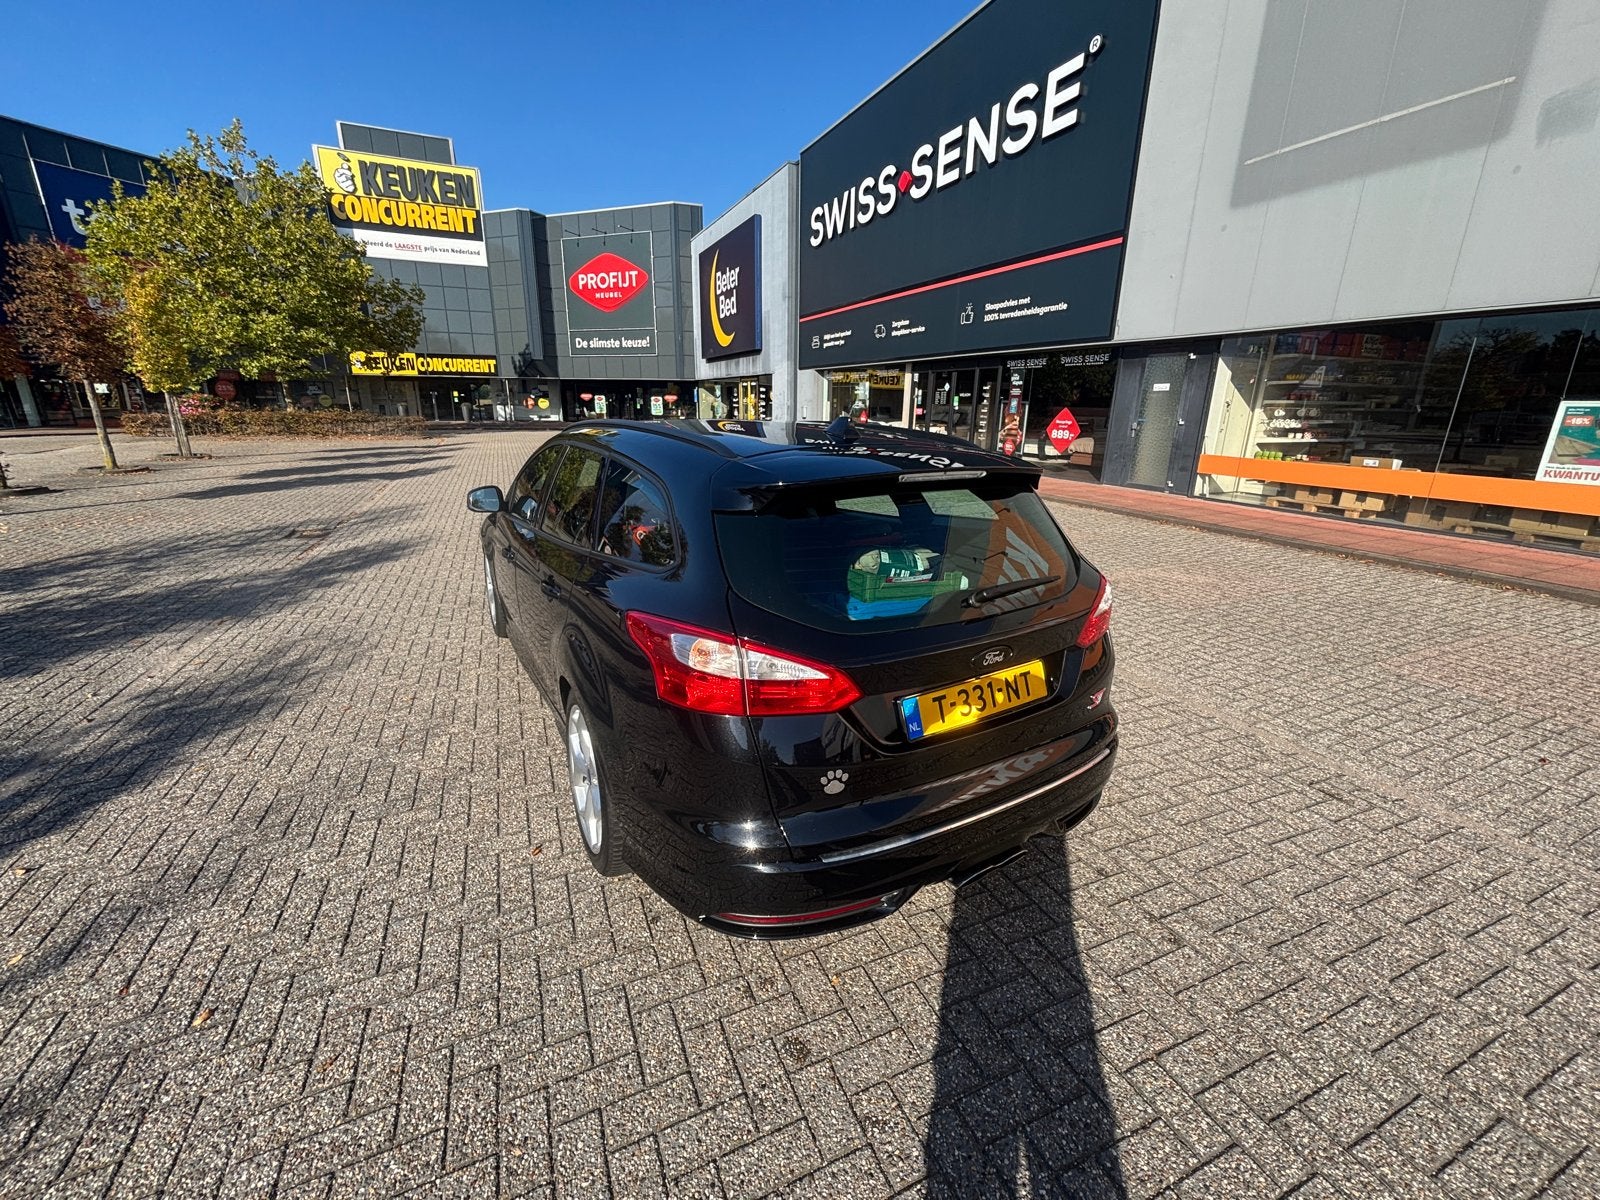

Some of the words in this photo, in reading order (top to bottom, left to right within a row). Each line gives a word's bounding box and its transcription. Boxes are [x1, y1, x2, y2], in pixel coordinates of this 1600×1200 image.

[810, 164, 897, 247] SWISS
[909, 52, 1086, 199] SENSE
[358, 160, 476, 208] KEUKEN
[331, 193, 477, 234] CONCURRENT
[394, 242, 422, 251] LAAGSTE
[450, 248, 480, 256] Nederland
[578, 270, 638, 290] PROFIJT
[716, 266, 740, 295] Beter
[595, 291, 622, 299] MEUBEL
[985, 298, 1018, 311] Slaapadvies
[1019, 296, 1031, 305] met
[719, 289, 737, 319] Bed
[984, 313, 999, 322] 100%
[999, 302, 1068, 320] tevredenheidsgarantie
[575, 337, 588, 349] De
[589, 337, 620, 348] slimste
[621, 336, 650, 348] keuze!
[366, 356, 414, 371] EUKEN
[417, 358, 497, 373] CONCURRENT
[1007, 360, 1025, 368] SWISS
[1026, 358, 1047, 367] SENSE
[1061, 355, 1083, 364] SWISS
[1085, 353, 1110, 363] SENSE
[982, 651, 1005, 666] Ford
[932, 670, 1031, 724] T-331-NT
[908, 721, 921, 733] NL
